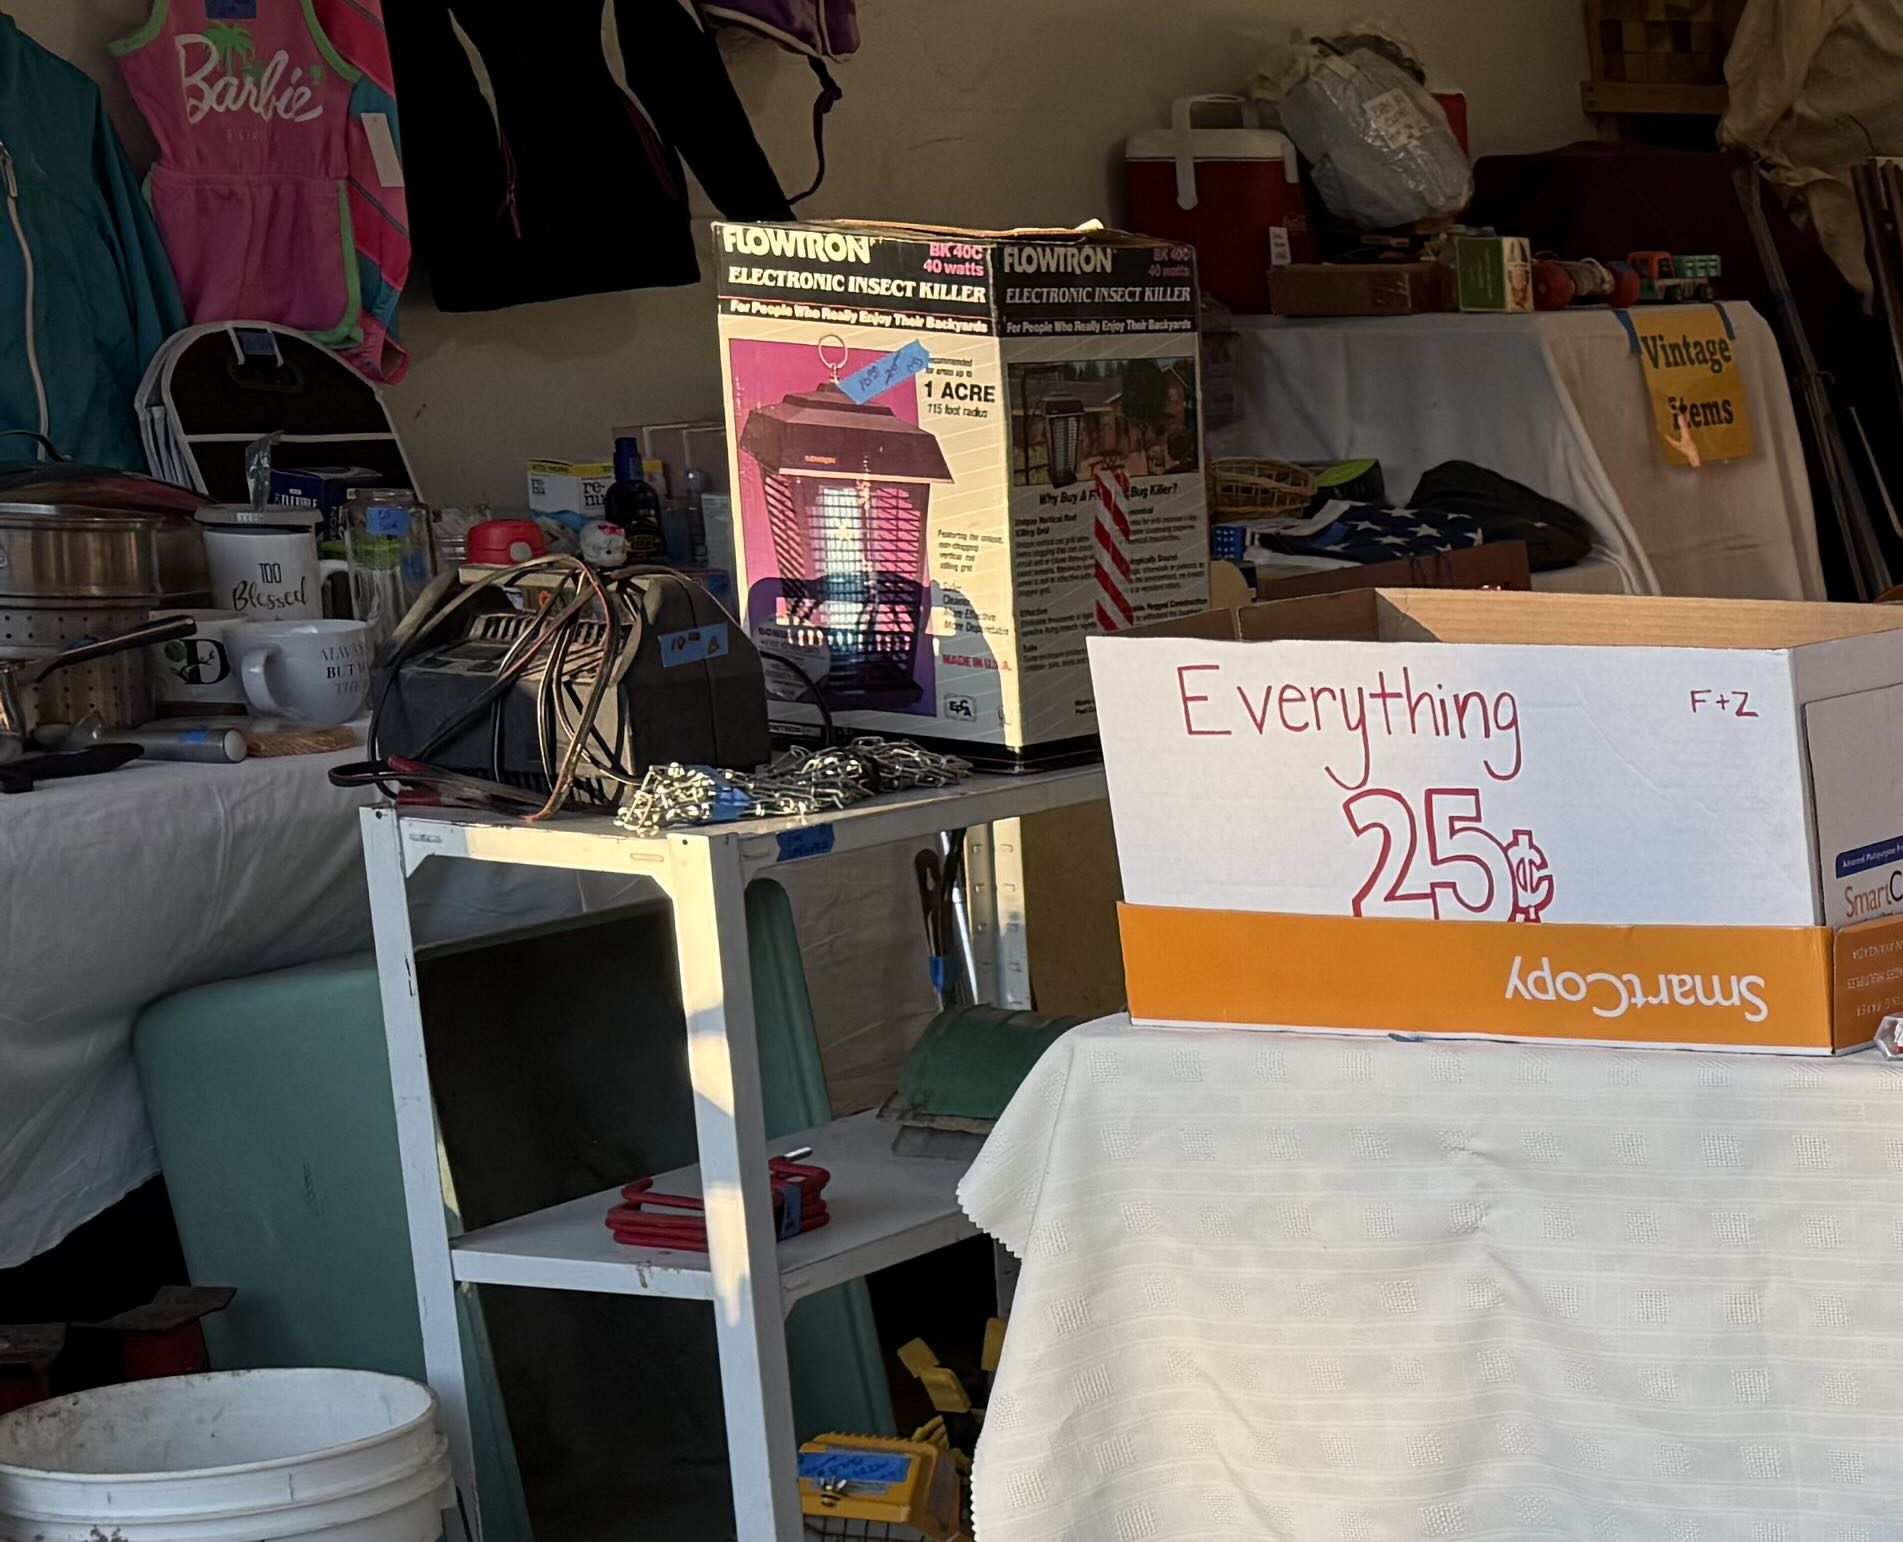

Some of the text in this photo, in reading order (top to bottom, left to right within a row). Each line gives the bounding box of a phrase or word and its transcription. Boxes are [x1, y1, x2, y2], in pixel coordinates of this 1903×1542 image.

[174, 33, 323, 125] Barbie
[723, 226, 871, 264] FLOWTRON
[929, 242, 983, 260] BK 40C
[1003, 245, 1112, 275] FLOWTRON
[728, 266, 987, 303] ELECTRONIC INSECT KILLER
[923, 259, 984, 277] 40 watts
[1006, 286, 1191, 303] ELECTRONIC INSECT KILLER
[730, 300, 988, 334] For People Who Really Enjoy Their Backyards
[1006, 319, 1191, 334] For People Who Really Enjoy Their Backyards
[1640, 333, 1732, 374] Vintage
[924, 380, 995, 403] 1 ACRE
[928, 403, 988, 419] 115 foot radius
[1667, 397, 1734, 430] items
[258, 563, 282, 584] TOO
[233, 576, 307, 611] Blessed
[1690, 689, 1760, 719] F+Z
[1177, 664, 1520, 789] Everything
[1343, 786, 1556, 925] 25¢
[1505, 956, 1768, 1023] SmartCopy
